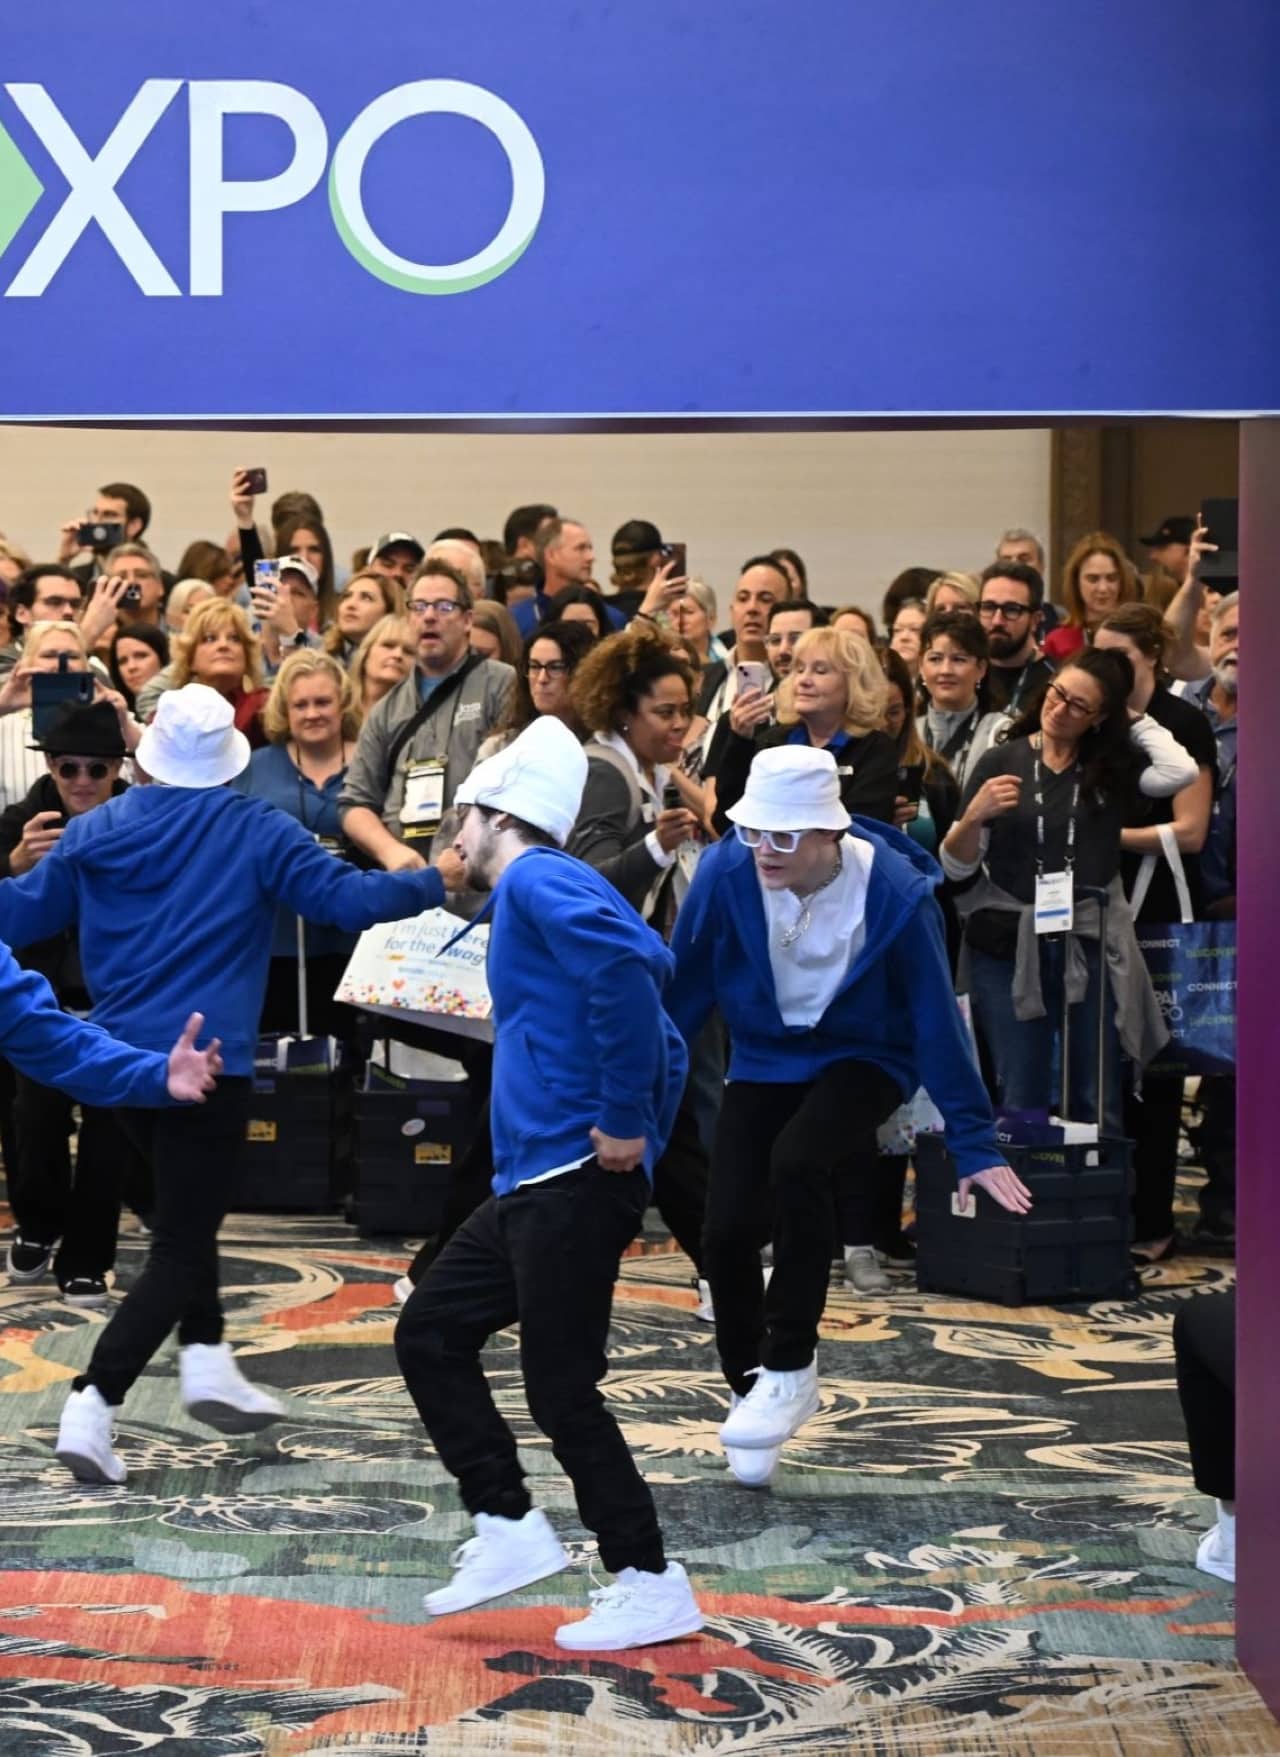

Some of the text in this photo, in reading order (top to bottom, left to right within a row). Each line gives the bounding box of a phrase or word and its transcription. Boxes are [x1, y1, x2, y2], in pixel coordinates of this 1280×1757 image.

[418, 924, 447, 937] just
[385, 936, 407, 951] for
[409, 939, 436, 953] the
[443, 947, 486, 966] wag
